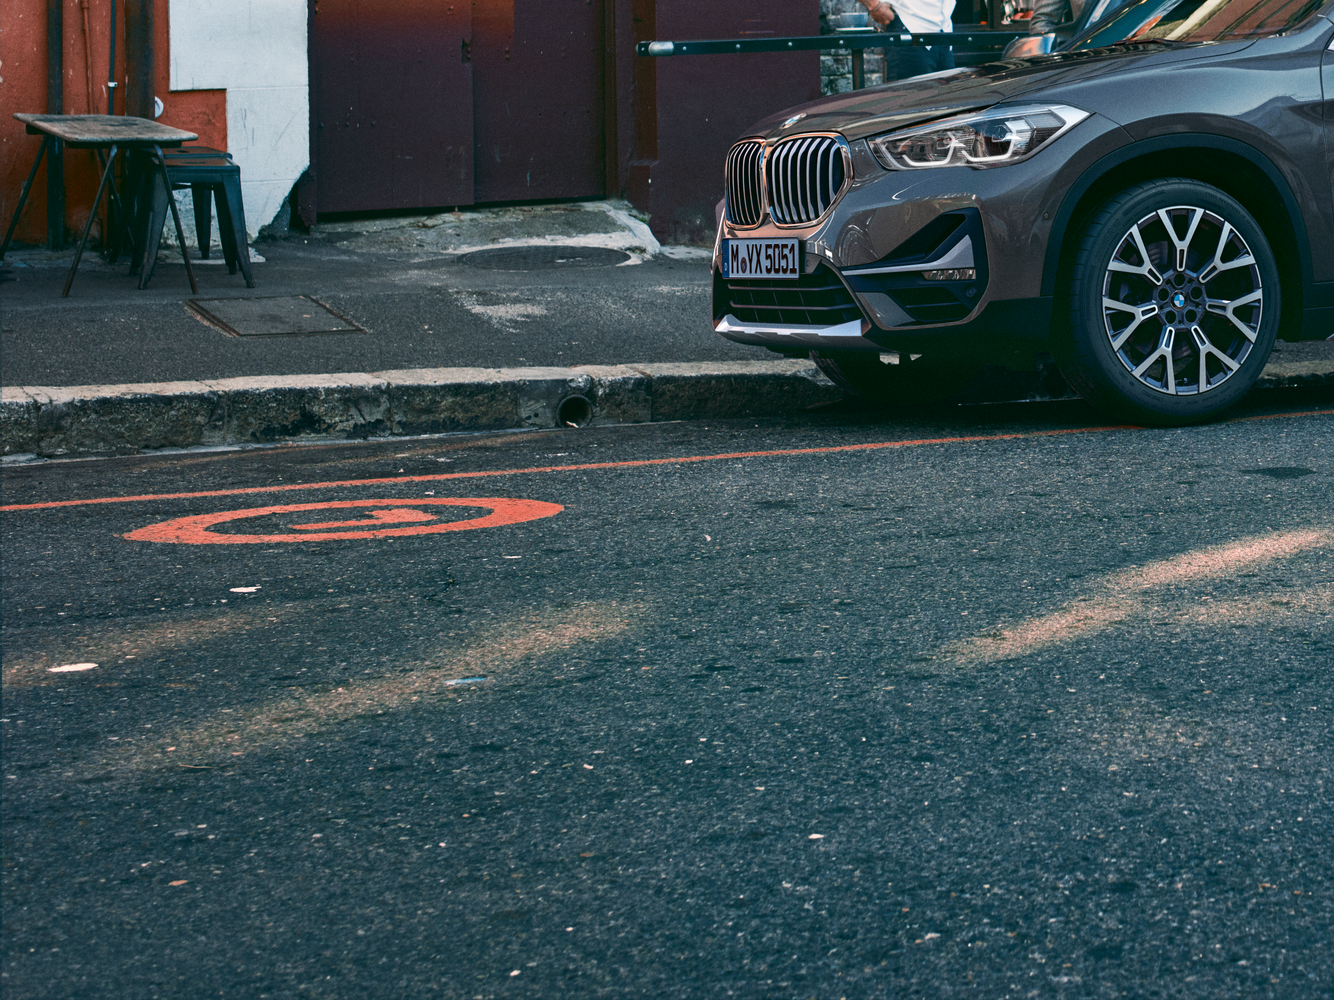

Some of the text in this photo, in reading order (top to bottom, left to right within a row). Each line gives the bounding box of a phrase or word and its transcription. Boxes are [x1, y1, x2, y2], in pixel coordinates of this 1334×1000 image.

[731, 243, 797, 274] M YX 5051
